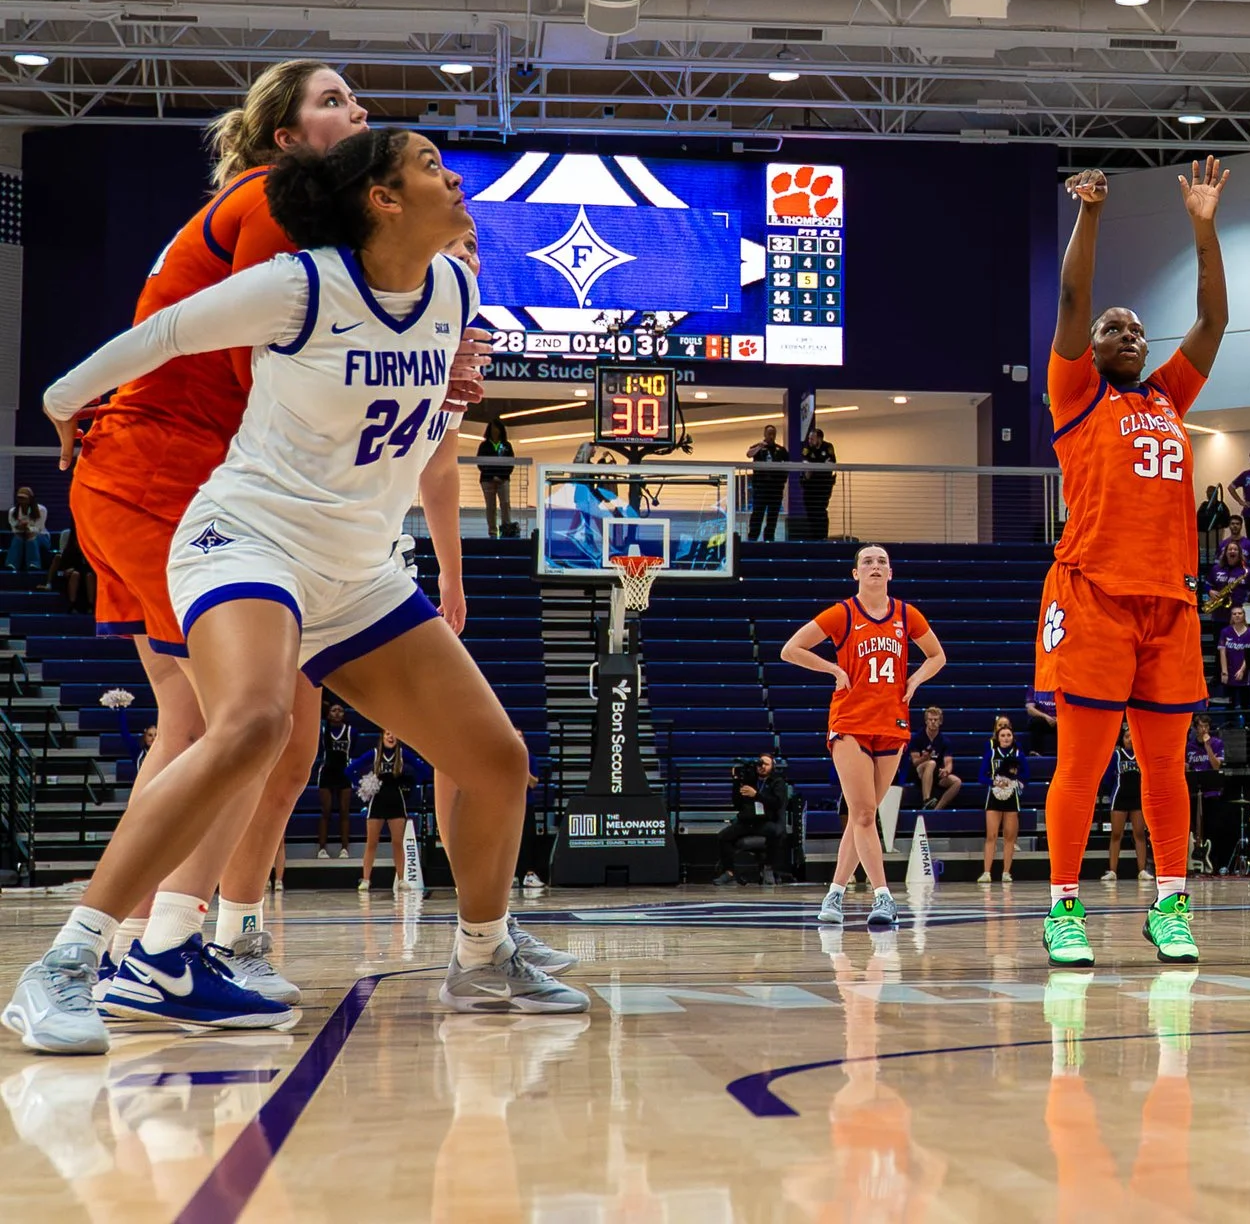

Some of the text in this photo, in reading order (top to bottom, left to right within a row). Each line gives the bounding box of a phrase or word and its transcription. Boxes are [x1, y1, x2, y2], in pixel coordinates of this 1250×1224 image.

[784, 216, 838, 226] THOMPSON
[798, 228, 840, 237] PTS FLS
[772, 238, 835, 251] 32 2 0
[773, 255, 835, 269] 10 4 0
[773, 273, 835, 287] 12 5 0
[773, 291, 835, 305] 14 1 1
[773, 308, 835, 322] 31 2 0
[492, 331, 702, 356] 28 2ND 01:40 30 FOULS
[685, 345, 695, 357] 4
[344, 349, 446, 387] FURMAN
[482, 362, 595, 379] PINX Stude
[626, 375, 666, 396] 1:40
[612, 398, 659, 436] 30
[354, 399, 431, 466] 24
[1133, 436, 1184, 481] 32
[858, 637, 902, 658] CLEMSON
[868, 657, 895, 683] 14
[611, 702, 625, 793] Bon Secours
[606, 820, 665, 829] MELONAKOS
[406, 838, 417, 882] FURMAN
[918, 833, 932, 876] FURMAN
